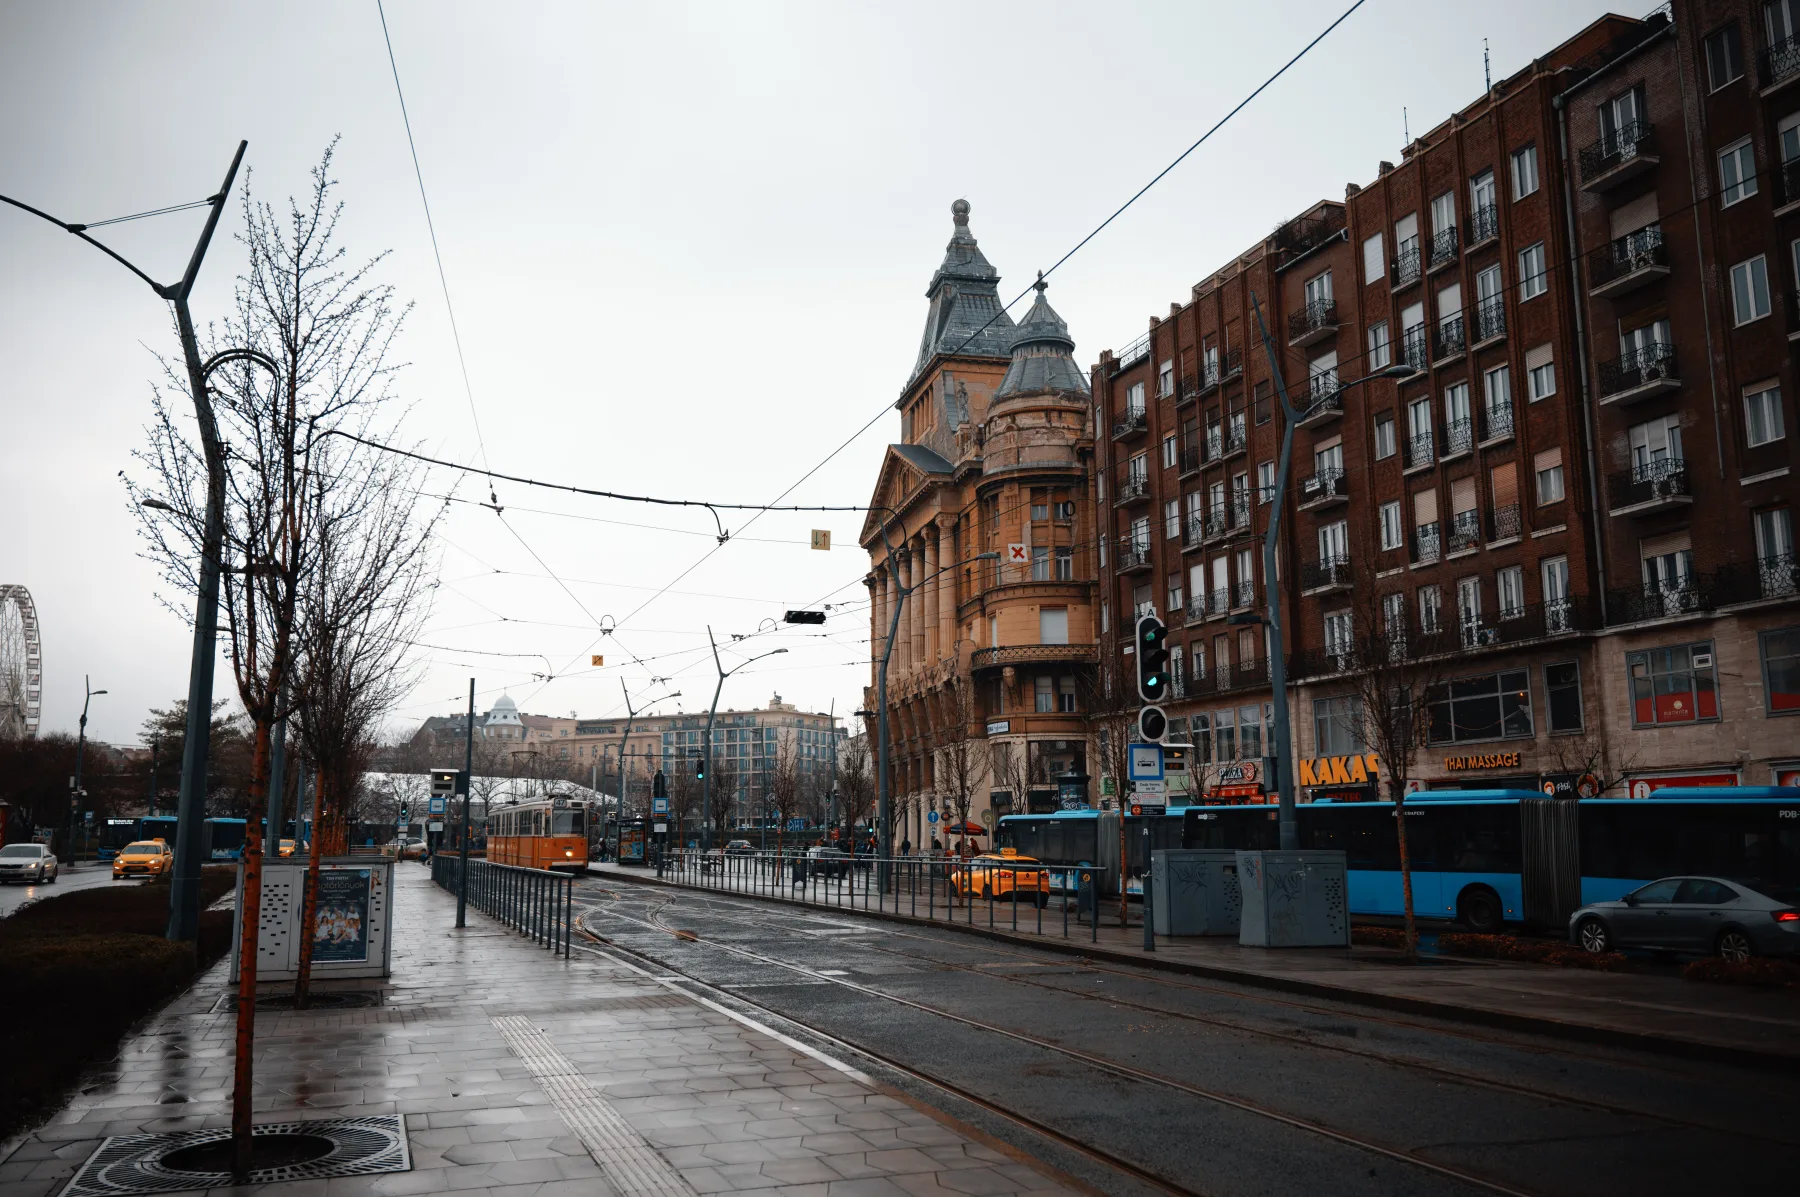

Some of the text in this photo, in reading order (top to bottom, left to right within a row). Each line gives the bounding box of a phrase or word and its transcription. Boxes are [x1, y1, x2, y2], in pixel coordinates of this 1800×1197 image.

[1147, 608, 1155, 617] A
[1444, 752, 1520, 771] THAI MASSAGE
[1299, 753, 1380, 787] KAKAS
[1779, 810, 1800, 819] PDB-
[1142, 827, 1149, 836] A
[317, 881, 365, 890] aptárlányok
